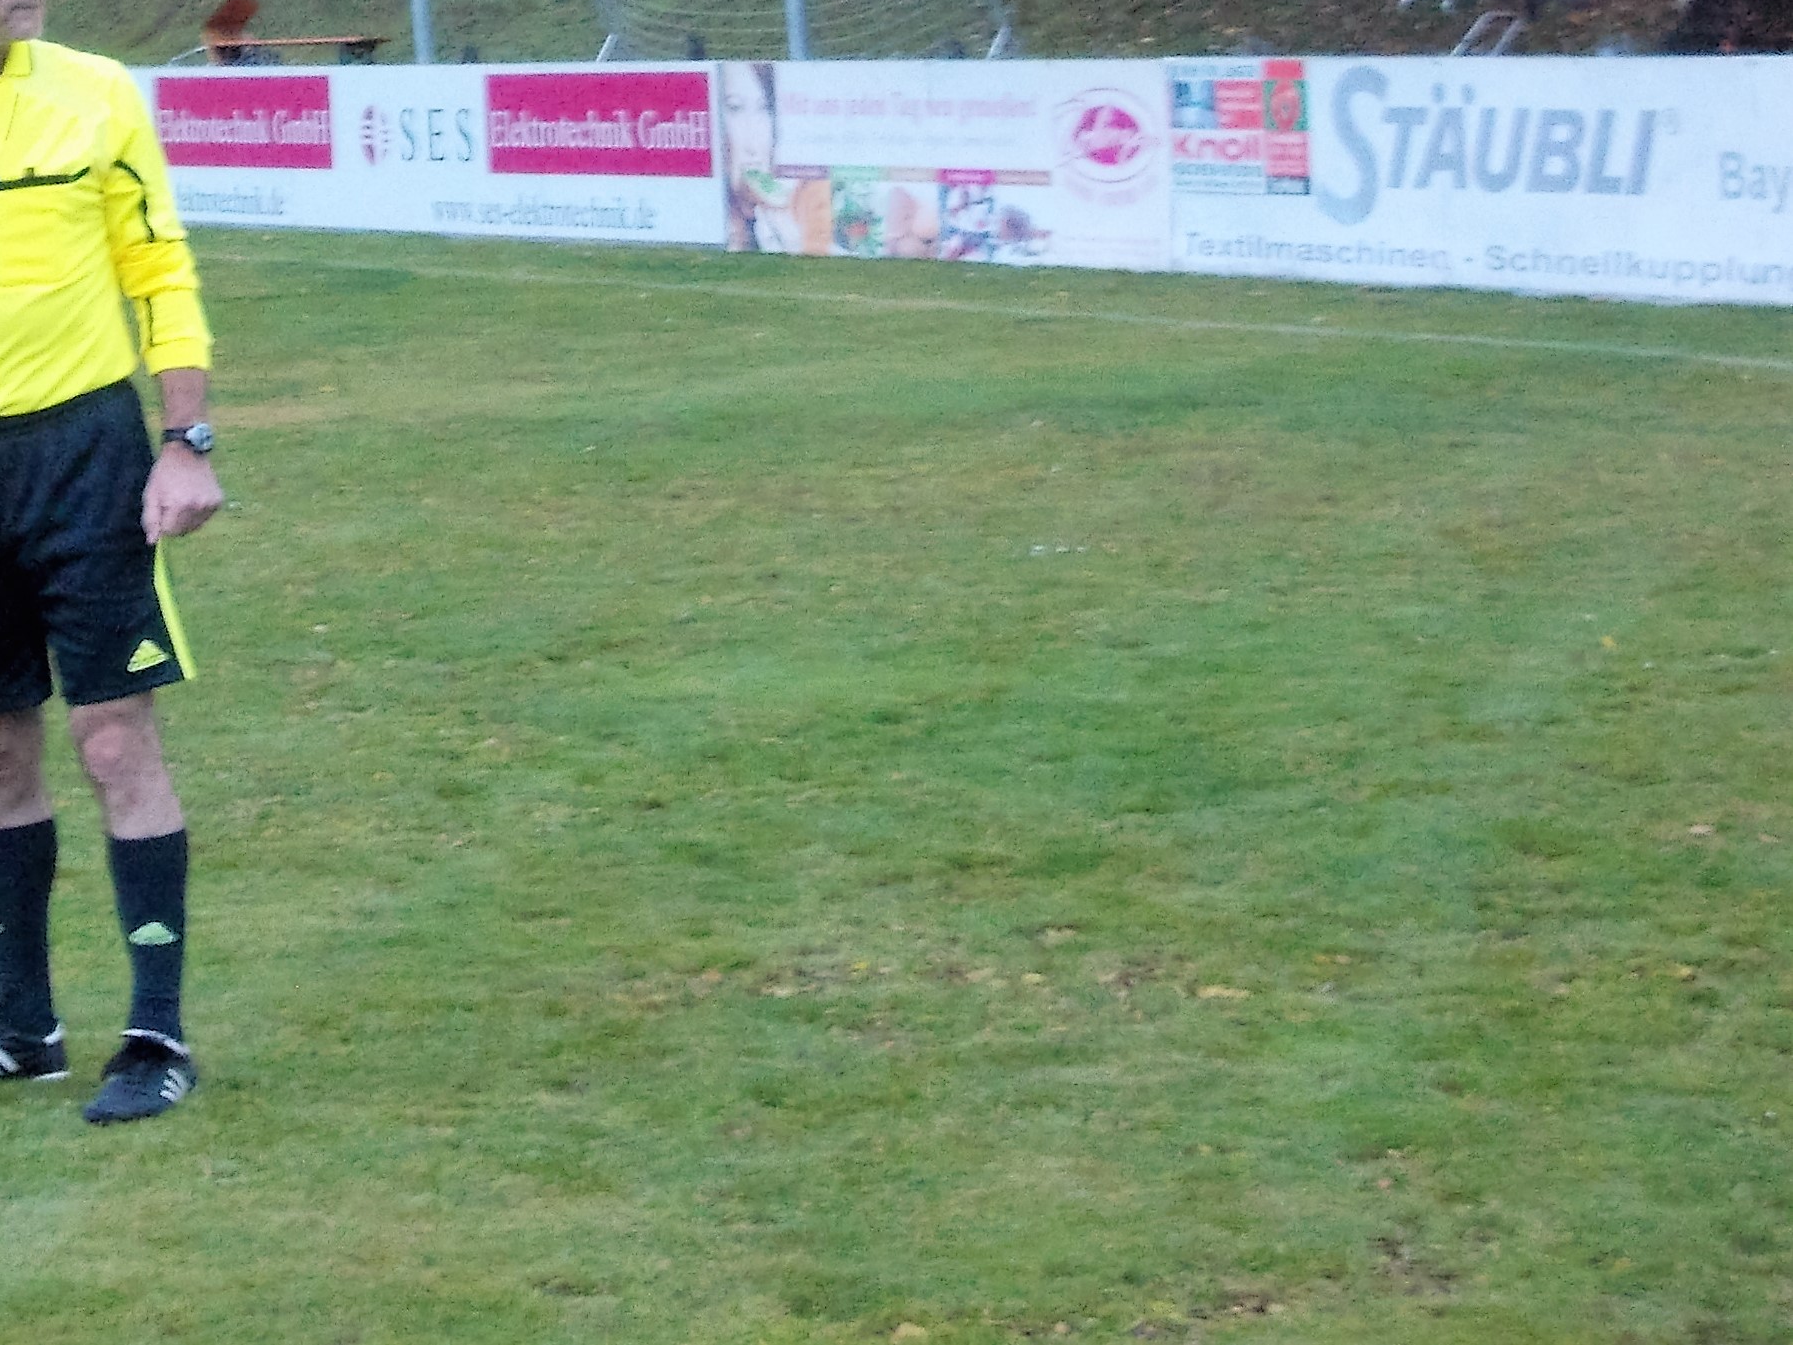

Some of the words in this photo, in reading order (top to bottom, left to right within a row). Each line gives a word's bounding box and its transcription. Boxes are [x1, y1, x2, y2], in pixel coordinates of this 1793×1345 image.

[399, 107, 473, 161] SES
[490, 110, 633, 147] Elektrotechnik
[637, 110, 709, 149] GmbH
[1316, 65, 1656, 225] STÄUBLI
[1186, 230, 1452, 270] Textilmaschinen
